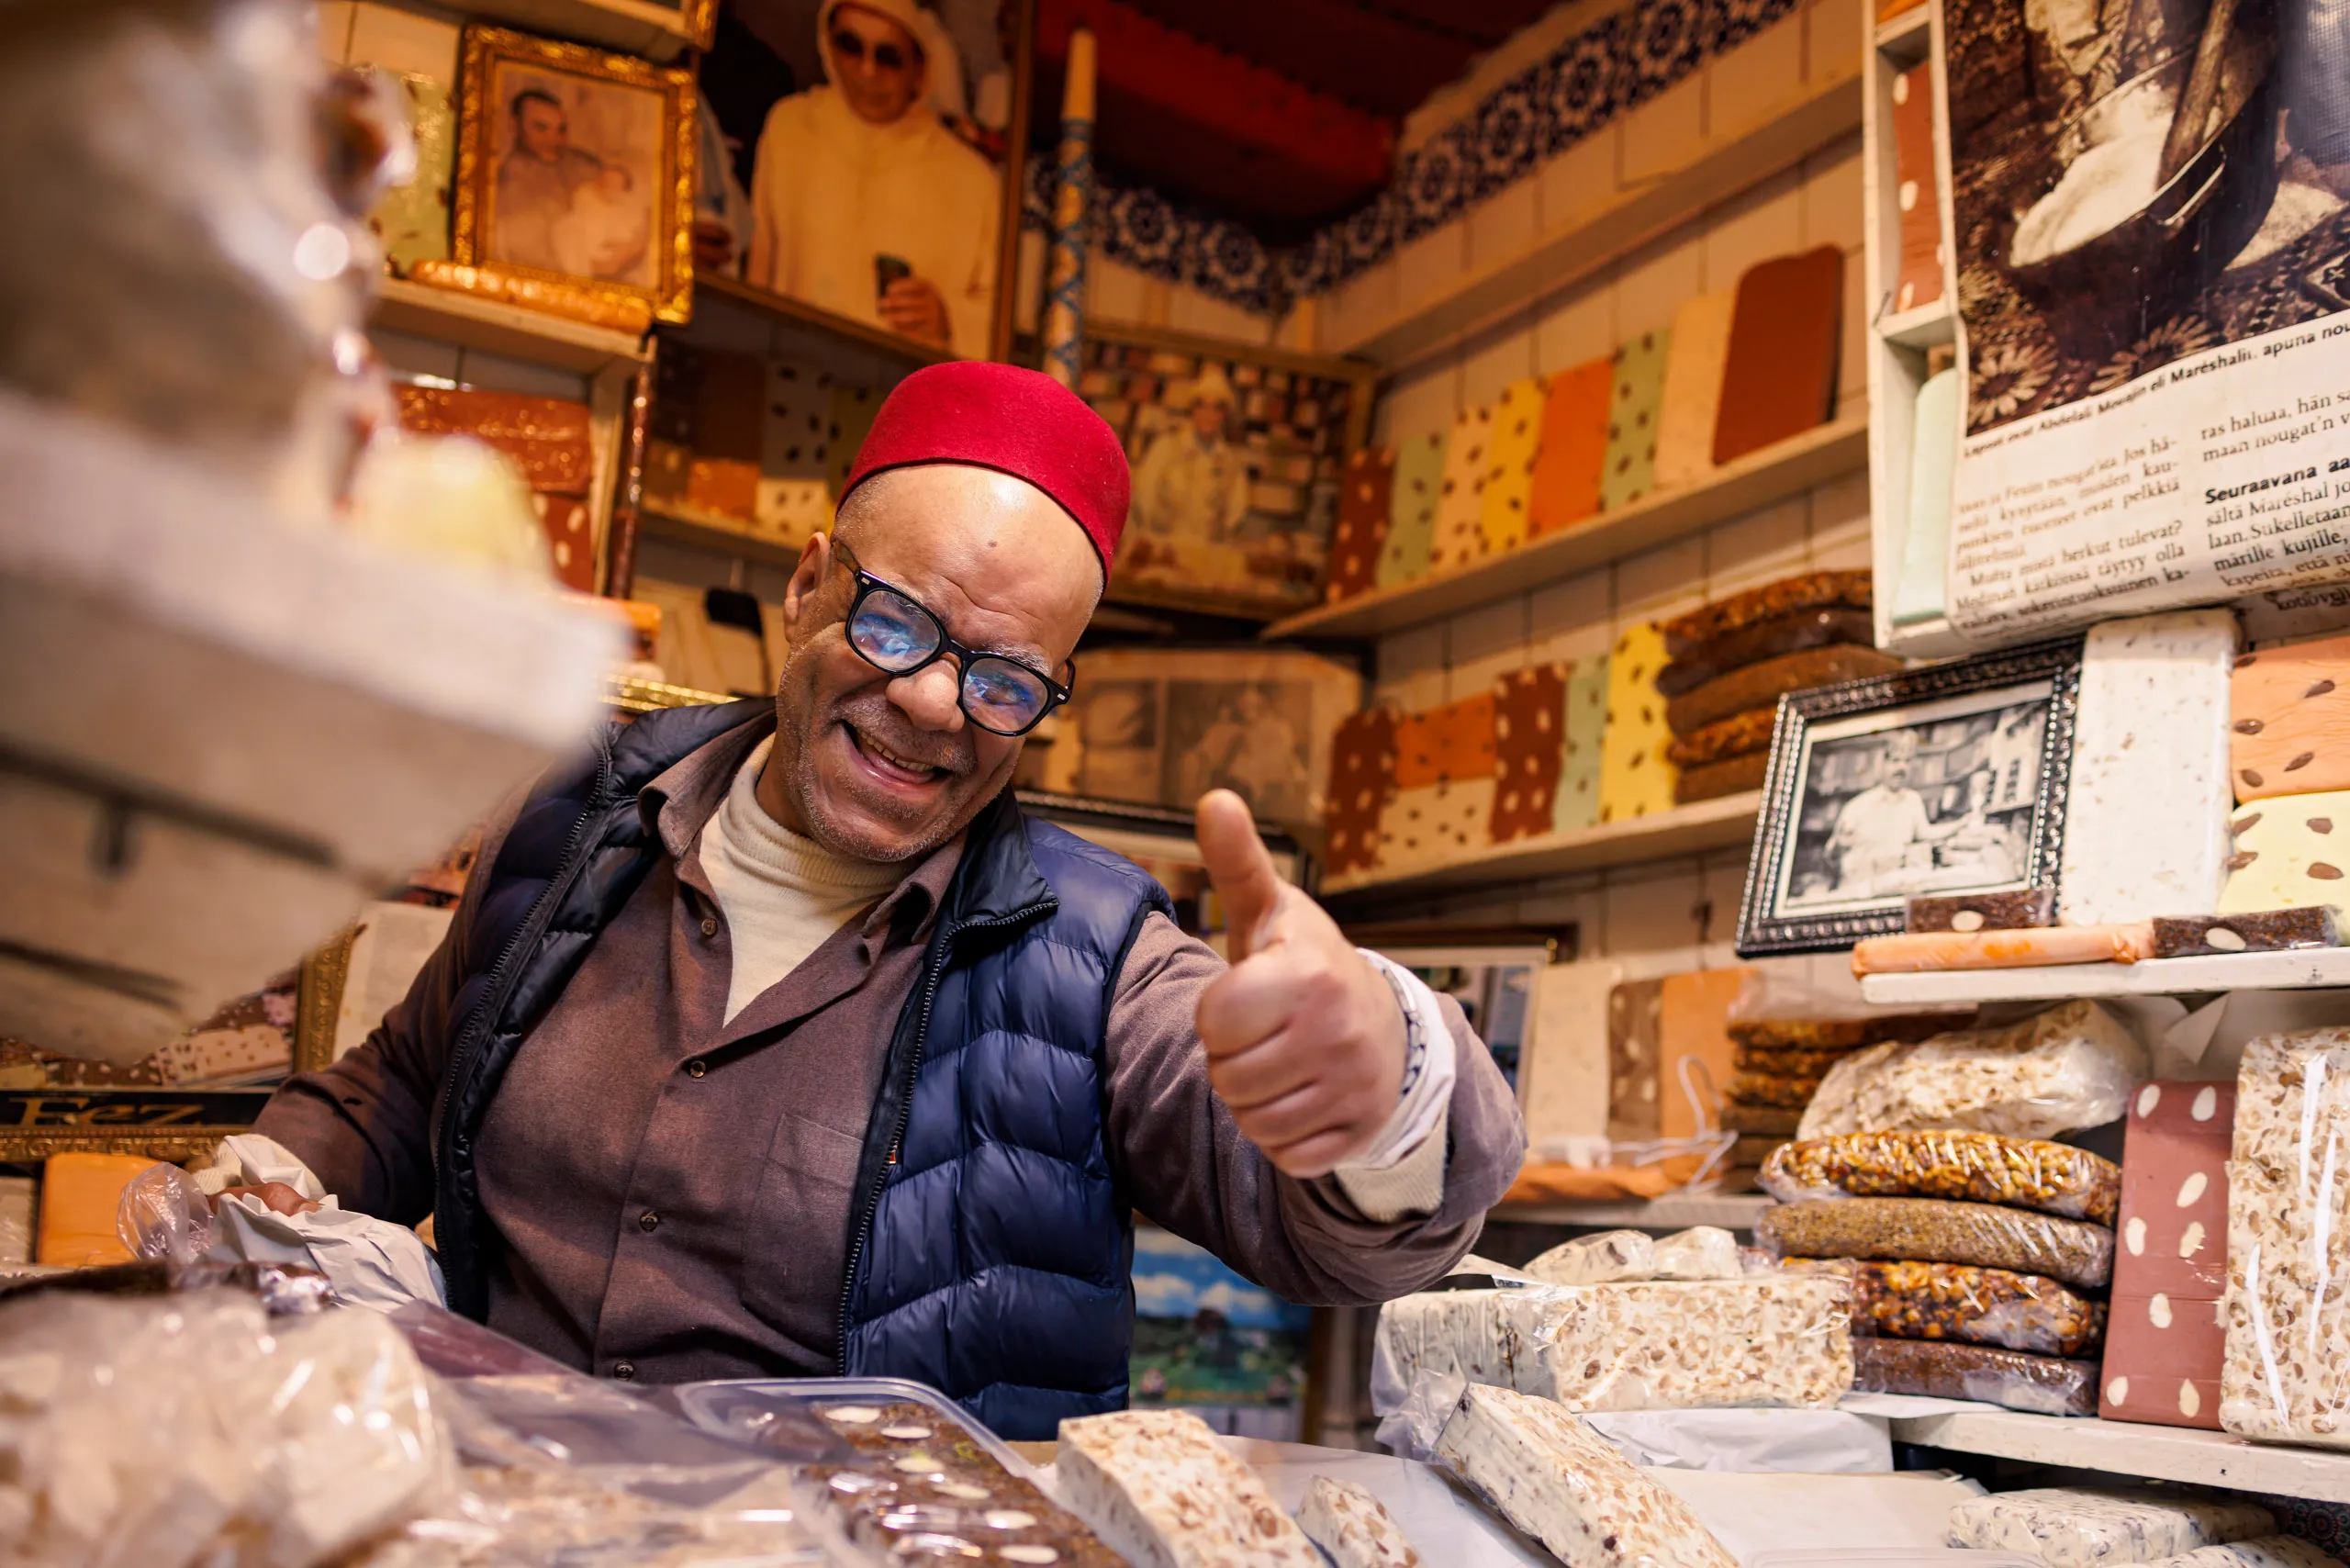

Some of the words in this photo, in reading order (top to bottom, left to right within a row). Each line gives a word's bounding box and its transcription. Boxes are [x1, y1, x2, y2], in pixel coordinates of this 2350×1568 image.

[2263, 333, 2315, 357] apuna
[2200, 423, 2225, 441] ras
[2230, 409, 2292, 432] haluaa,
[2298, 395, 2332, 414] hän
[2123, 446, 2146, 465] Jos
[2150, 436, 2178, 455] hä-
[2203, 440, 2249, 462] maan
[2255, 414, 2334, 449] nougat'n
[2143, 459, 2179, 478] kau-
[2205, 465, 2317, 505] Seuraavana
[2122, 476, 2180, 509] pelkkiä
[2207, 504, 2244, 527] sältä
[2249, 481, 2329, 517] Maréshal
[2062, 537, 2112, 564] herkut
[2119, 520, 2183, 549] tulevat?
[2098, 553, 2147, 578] täytyy
[2155, 541, 2186, 563] olla
[2213, 543, 2276, 572] märille
[2281, 527, 2348, 556] kujille,
[2163, 566, 2191, 585] ka-
[2296, 554, 2331, 573] että
[7, 1097, 205, 1127] Fez
